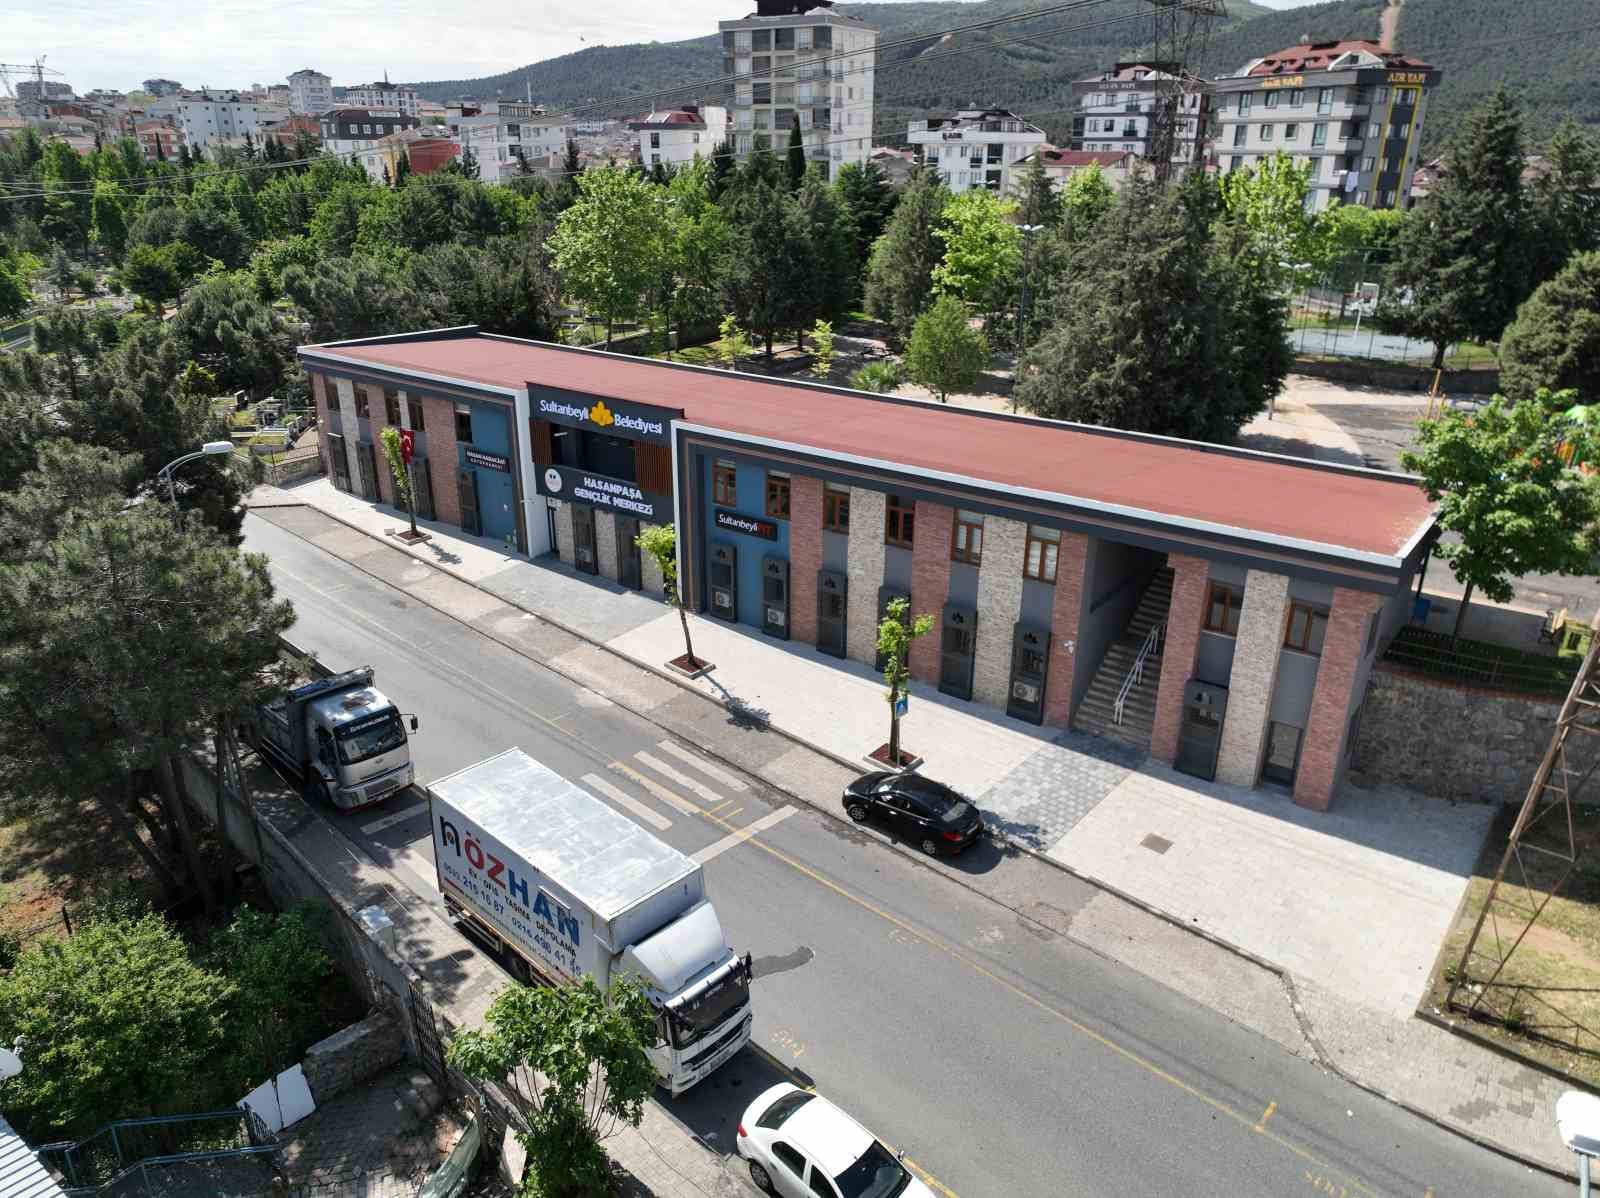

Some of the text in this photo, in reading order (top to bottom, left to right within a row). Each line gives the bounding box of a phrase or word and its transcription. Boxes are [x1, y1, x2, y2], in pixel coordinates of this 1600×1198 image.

[540, 399, 662, 434] Sultanbeyli Belediyesi
[574, 487, 653, 516] GENÇLİK MERKEZİ
[583, 476, 643, 500] HASANPAŞA
[463, 830, 580, 946] ÖZHAN
